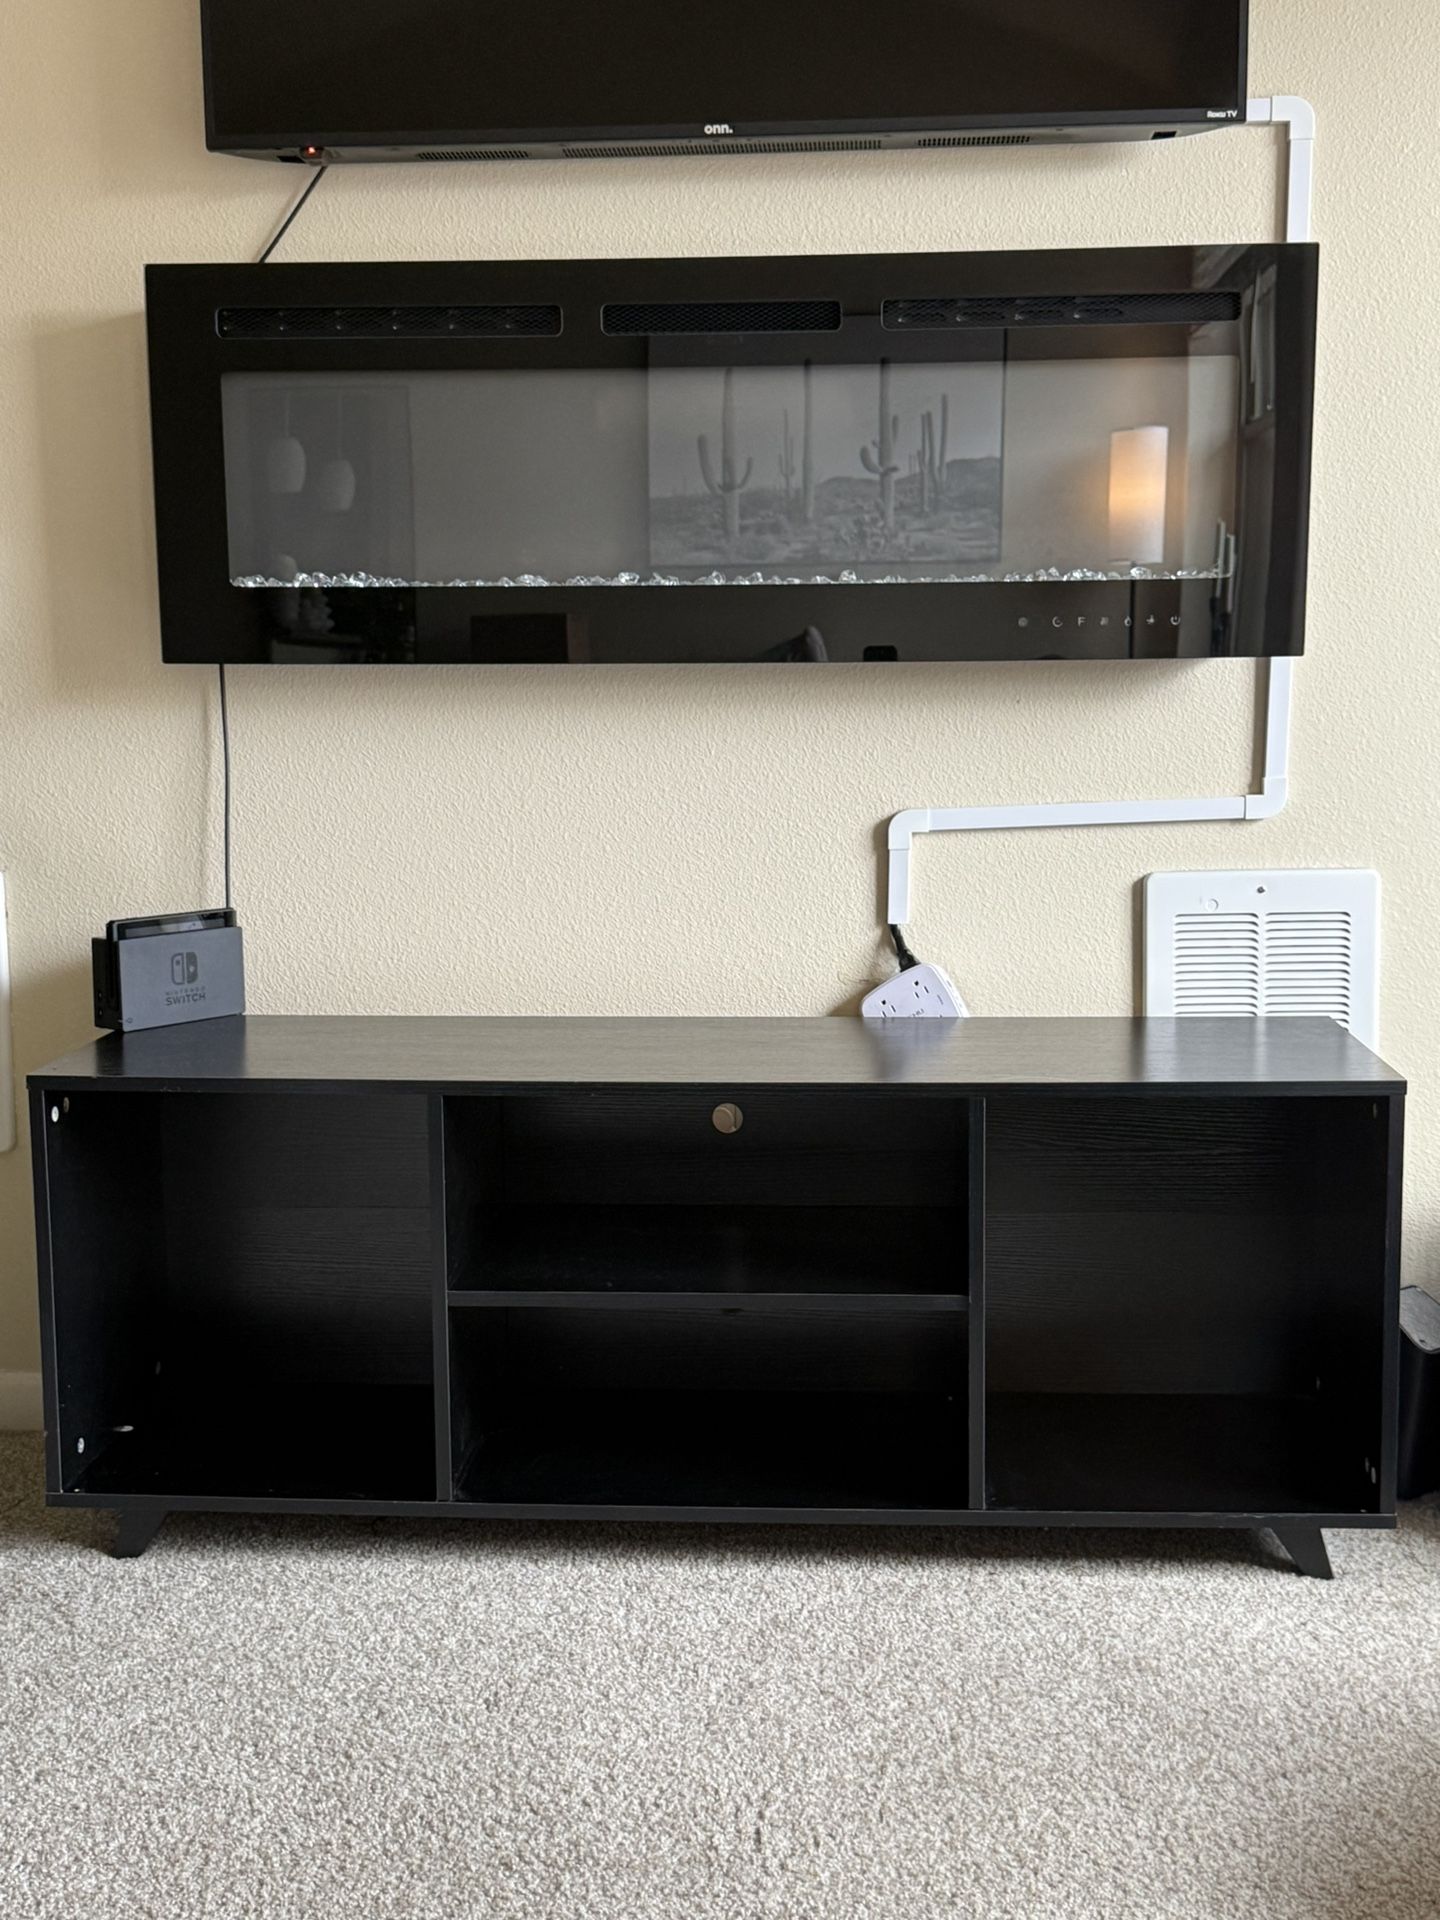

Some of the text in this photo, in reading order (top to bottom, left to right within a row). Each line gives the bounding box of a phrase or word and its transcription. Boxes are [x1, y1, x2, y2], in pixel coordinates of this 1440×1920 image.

[1227, 110, 1238, 118] TV
[704, 124, 734, 135] onn.
[165, 992, 206, 1006] SWITCH
